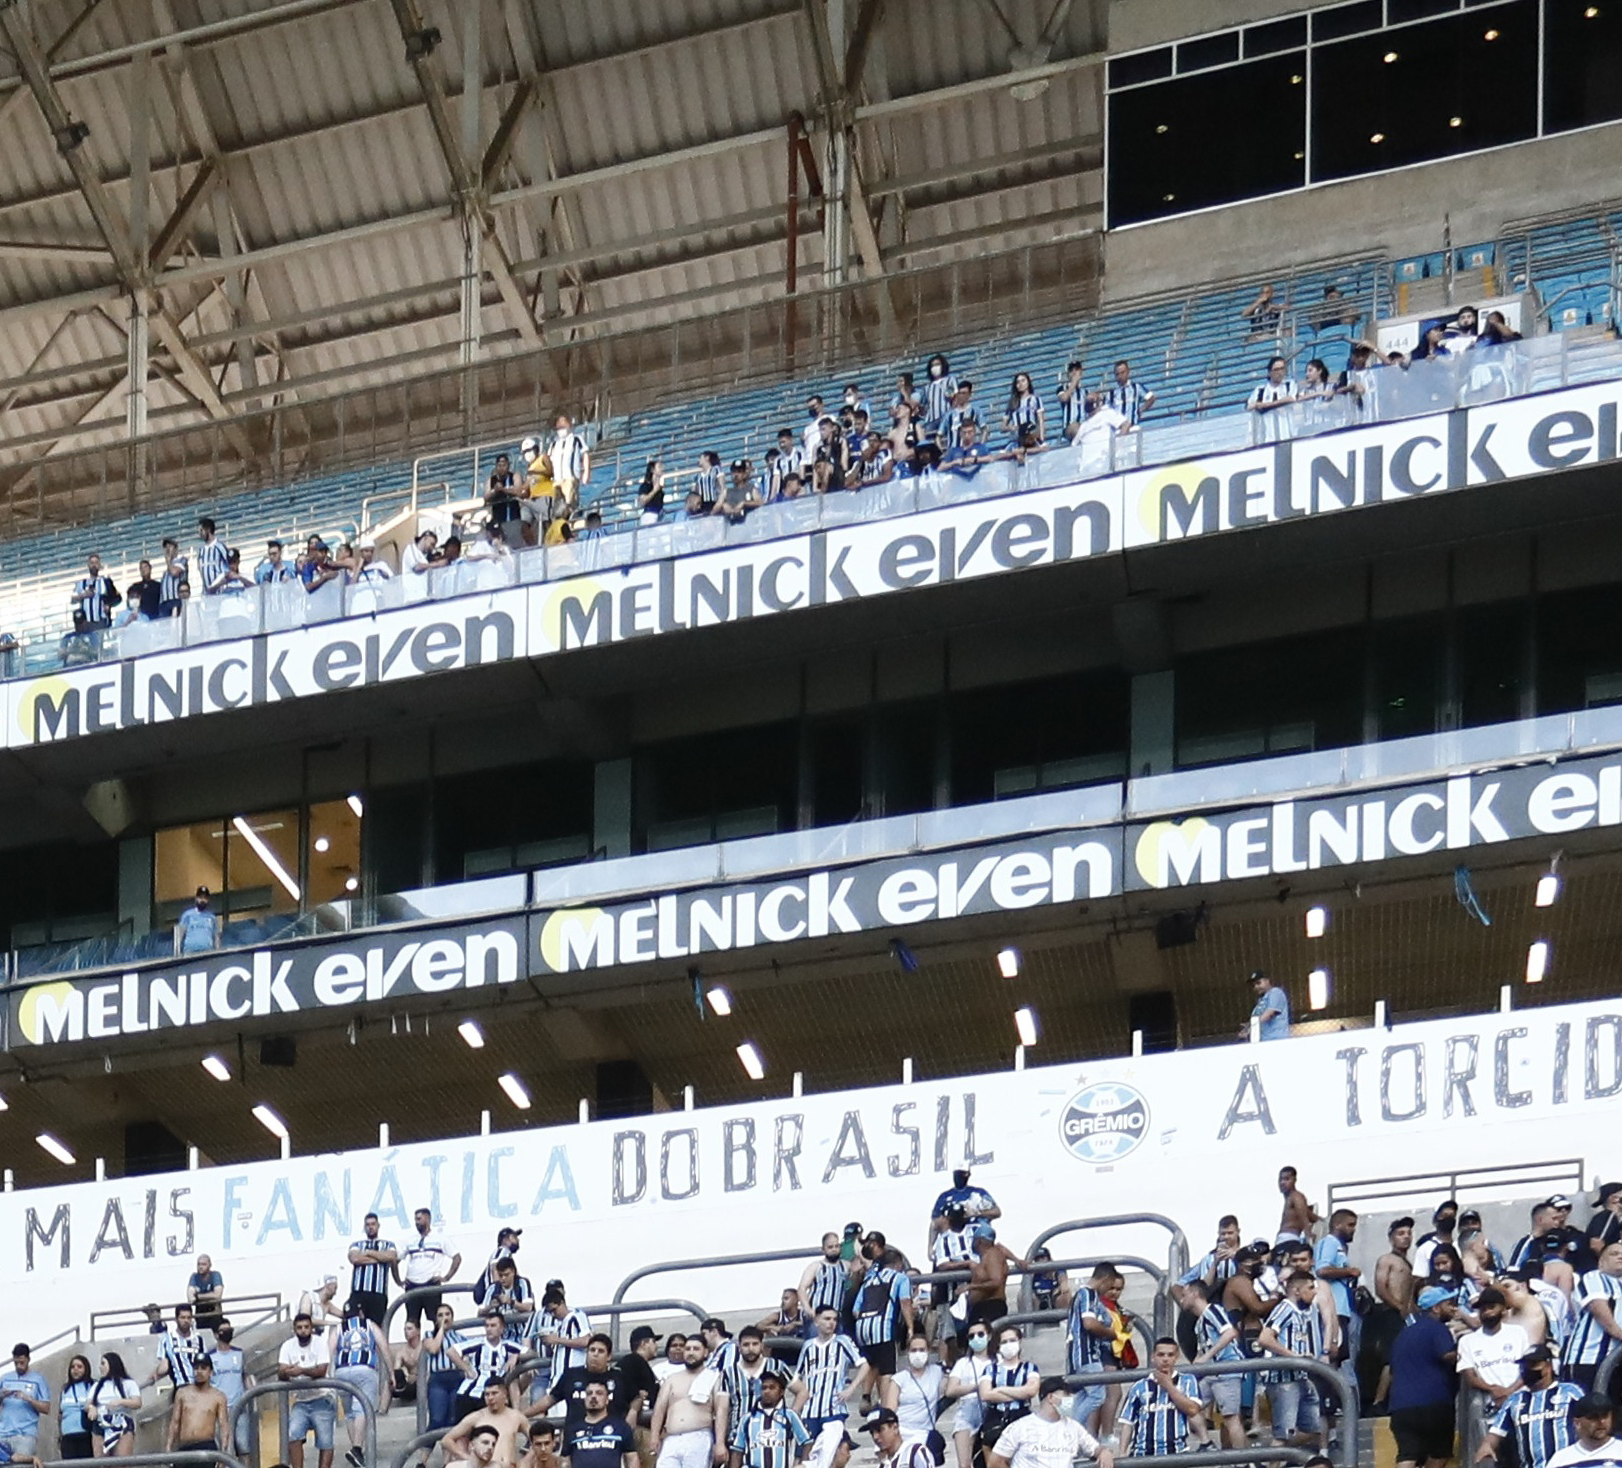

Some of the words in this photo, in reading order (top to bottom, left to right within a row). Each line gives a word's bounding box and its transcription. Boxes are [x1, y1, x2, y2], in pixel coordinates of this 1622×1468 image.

[1062, 1115, 1147, 1139] GRÊMIO
[1217, 1063, 1277, 1141] A
[24, 1187, 195, 1274] MAIS
[220, 1140, 582, 1250] FANÁTICA
[611, 1127, 700, 1207] DO
[722, 1092, 995, 1194] BRASIL
